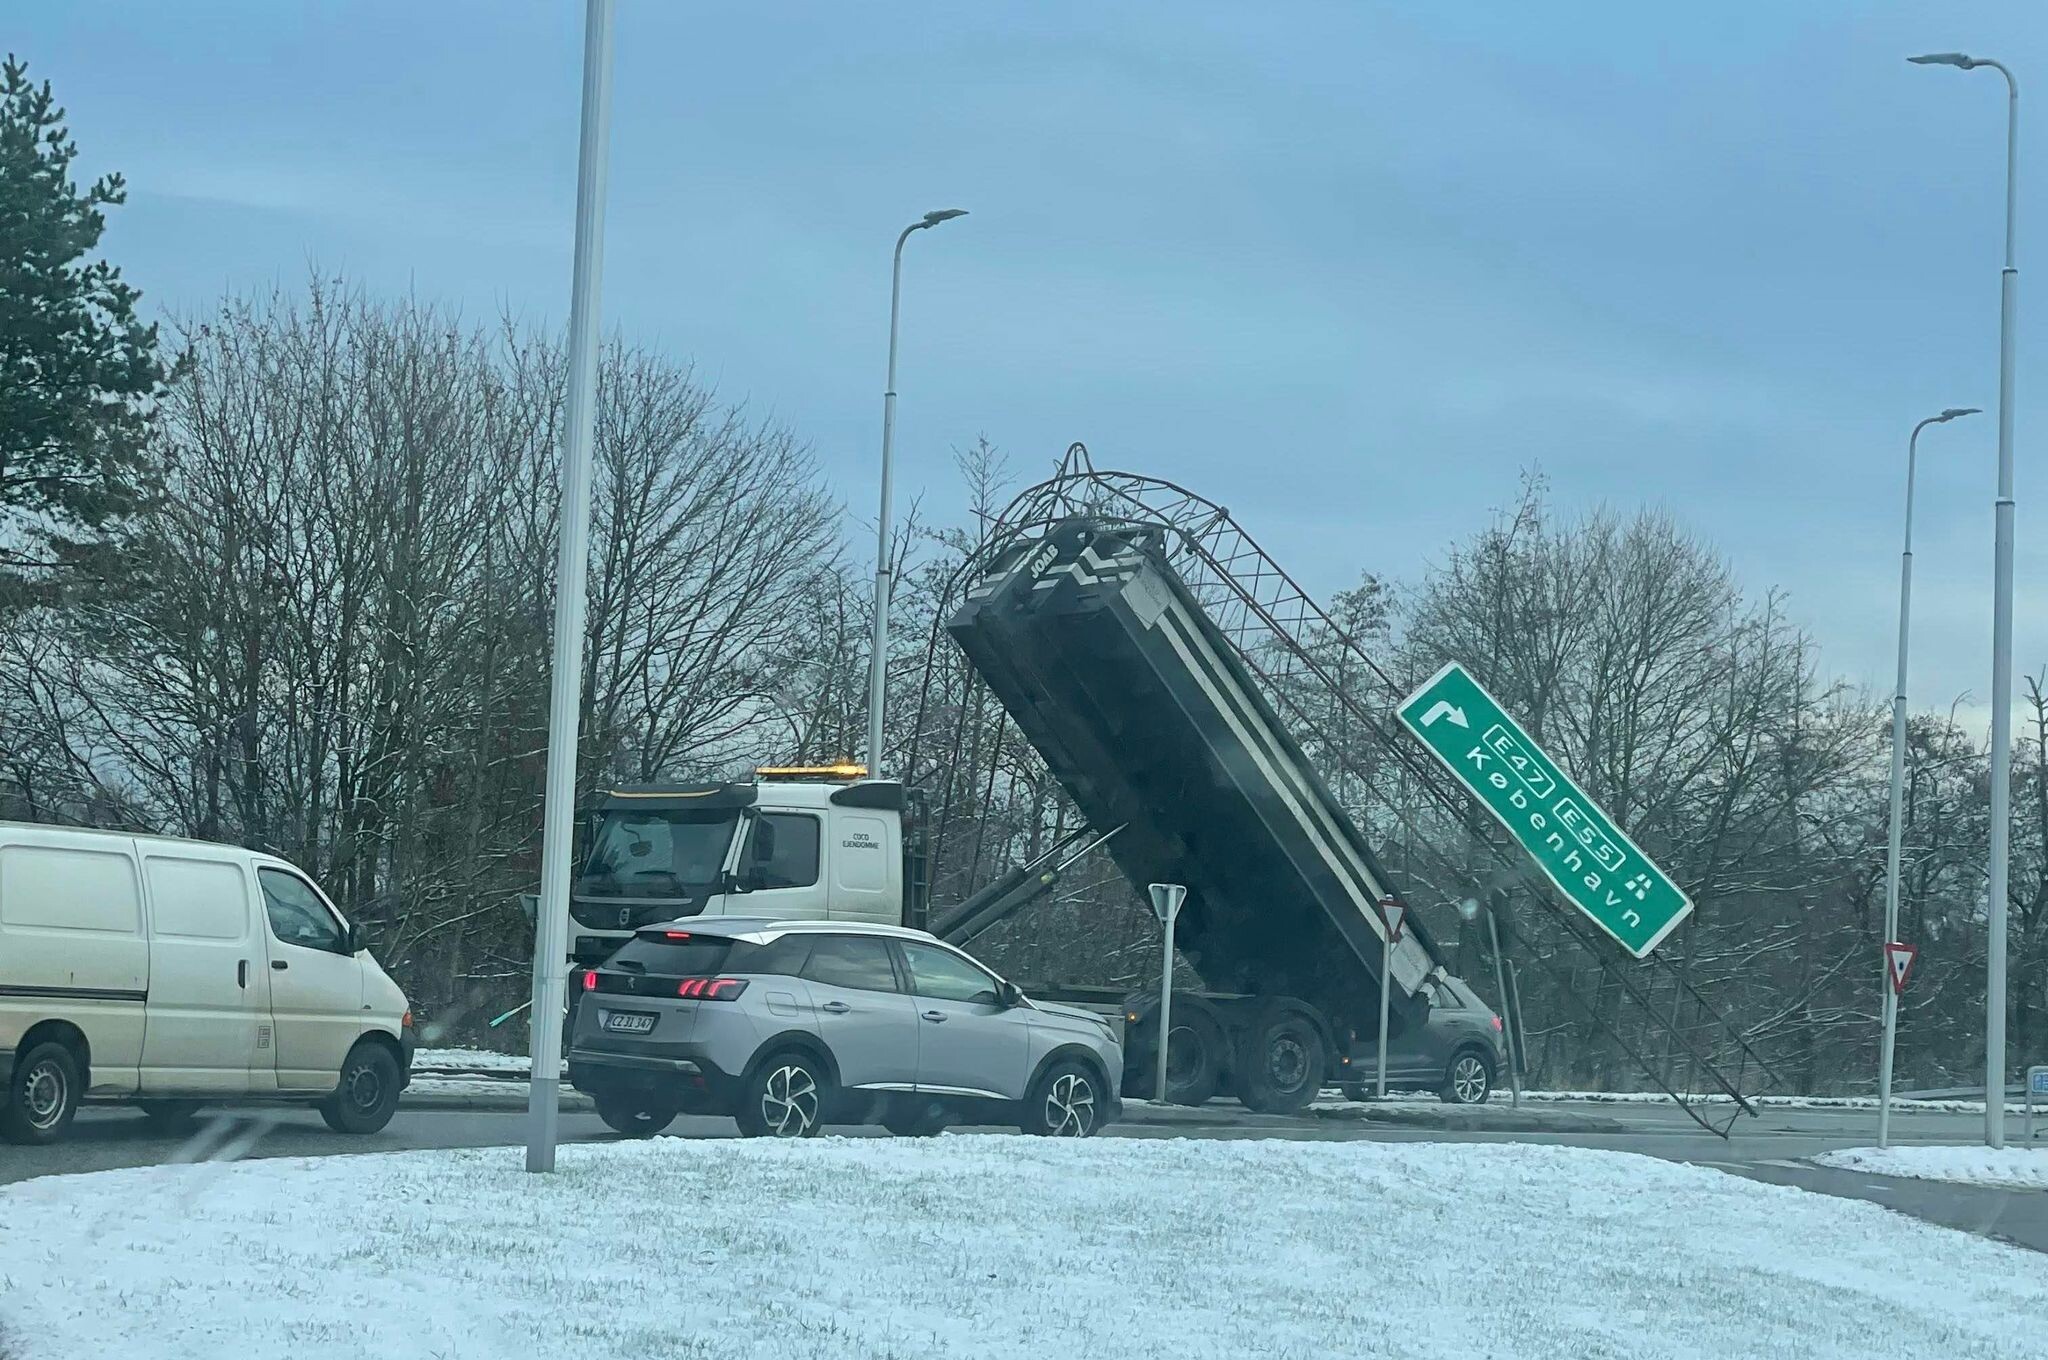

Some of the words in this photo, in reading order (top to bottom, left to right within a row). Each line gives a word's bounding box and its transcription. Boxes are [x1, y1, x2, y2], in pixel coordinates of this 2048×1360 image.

[1031, 544, 1059, 579] JOAB
[853, 833, 870, 841] COCO
[1466, 746, 1641, 928] København
